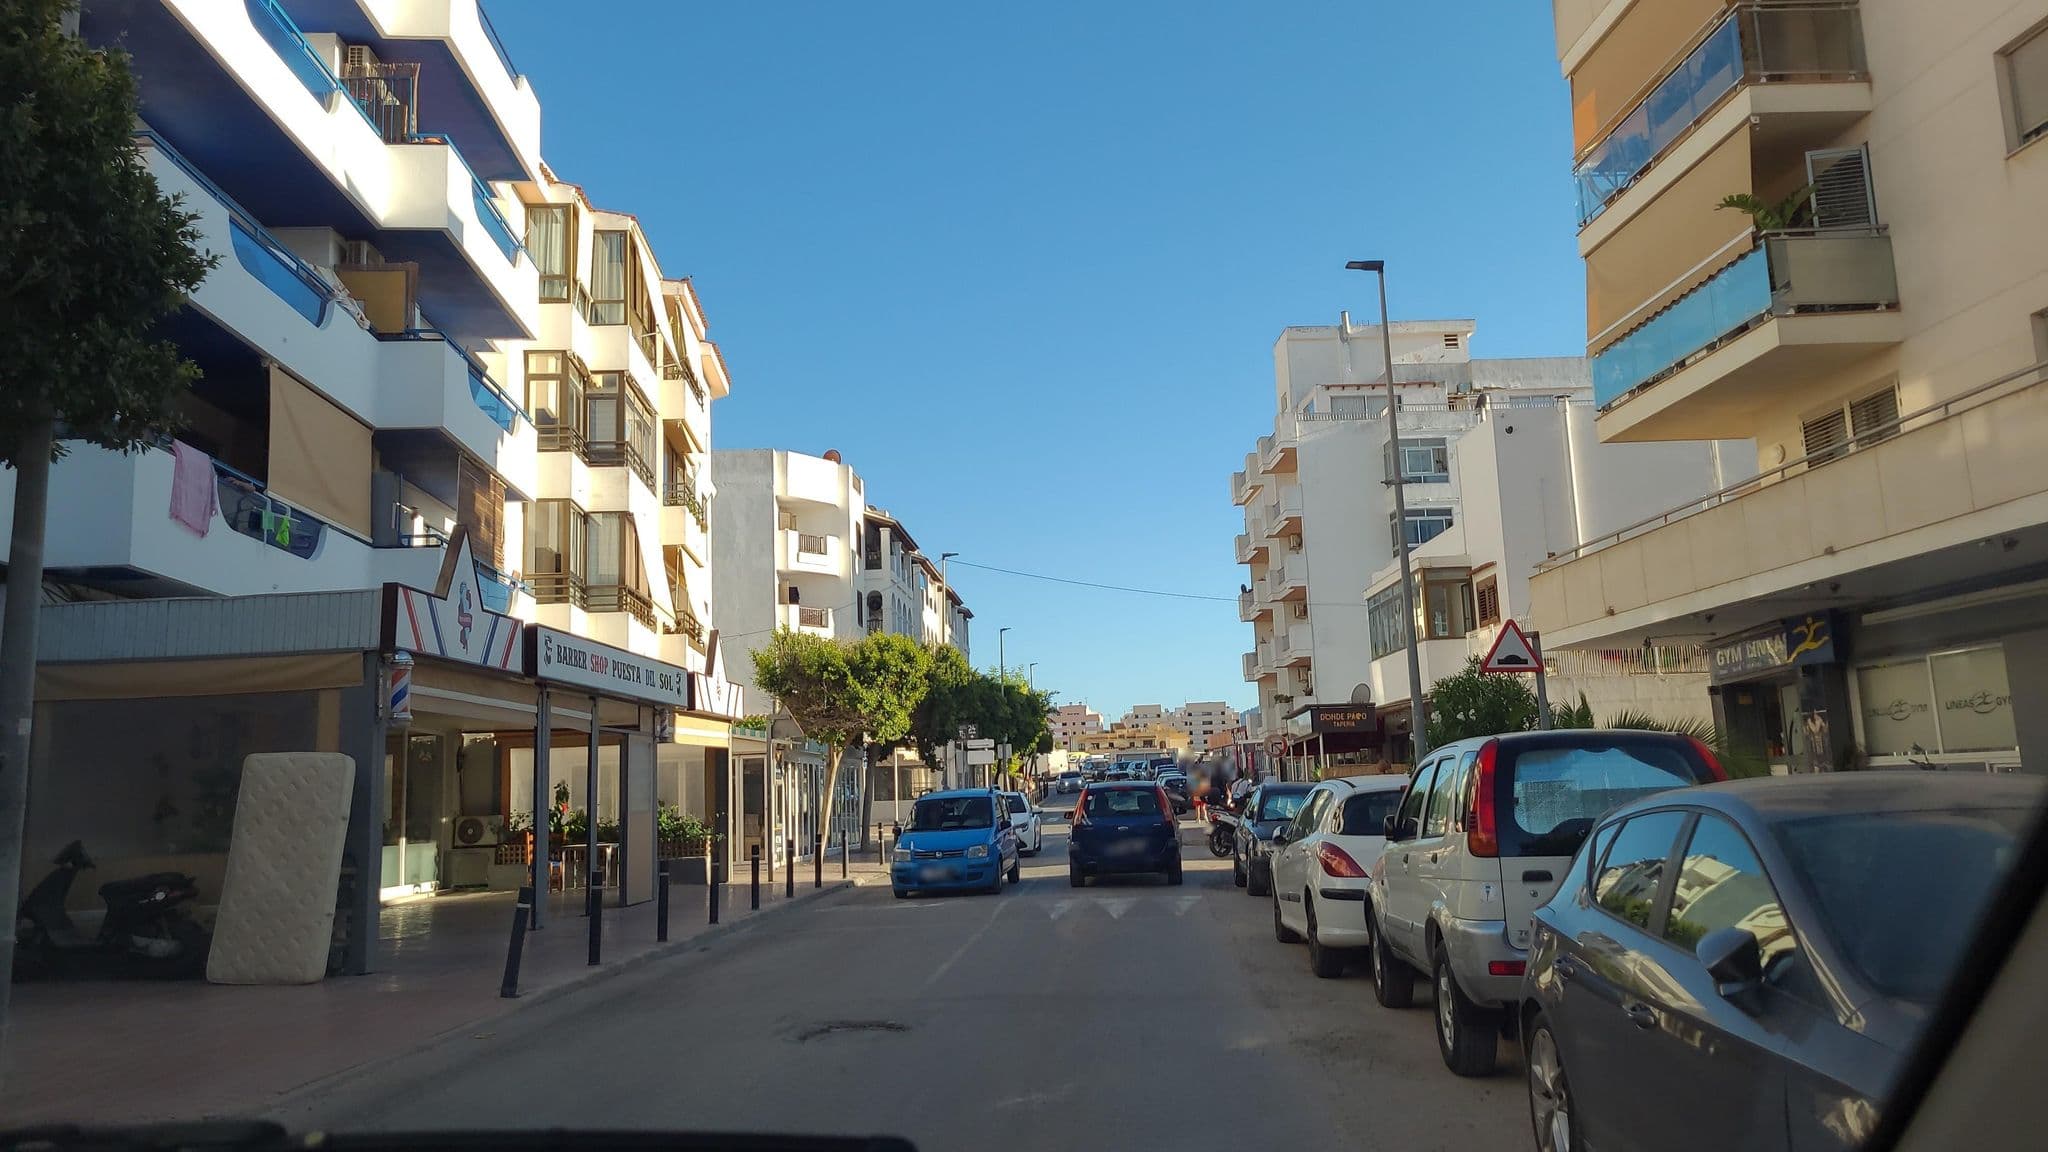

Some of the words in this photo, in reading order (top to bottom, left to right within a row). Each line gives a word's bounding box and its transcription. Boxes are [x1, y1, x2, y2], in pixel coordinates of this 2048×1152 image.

[556, 644, 588, 670] BARBER
[590, 653, 609, 675] SHOP
[612, 659, 642, 684] PUESTA
[645, 669, 656, 688] DEL
[659, 673, 674, 692] SOL
[1716, 646, 1743, 666] GYM
